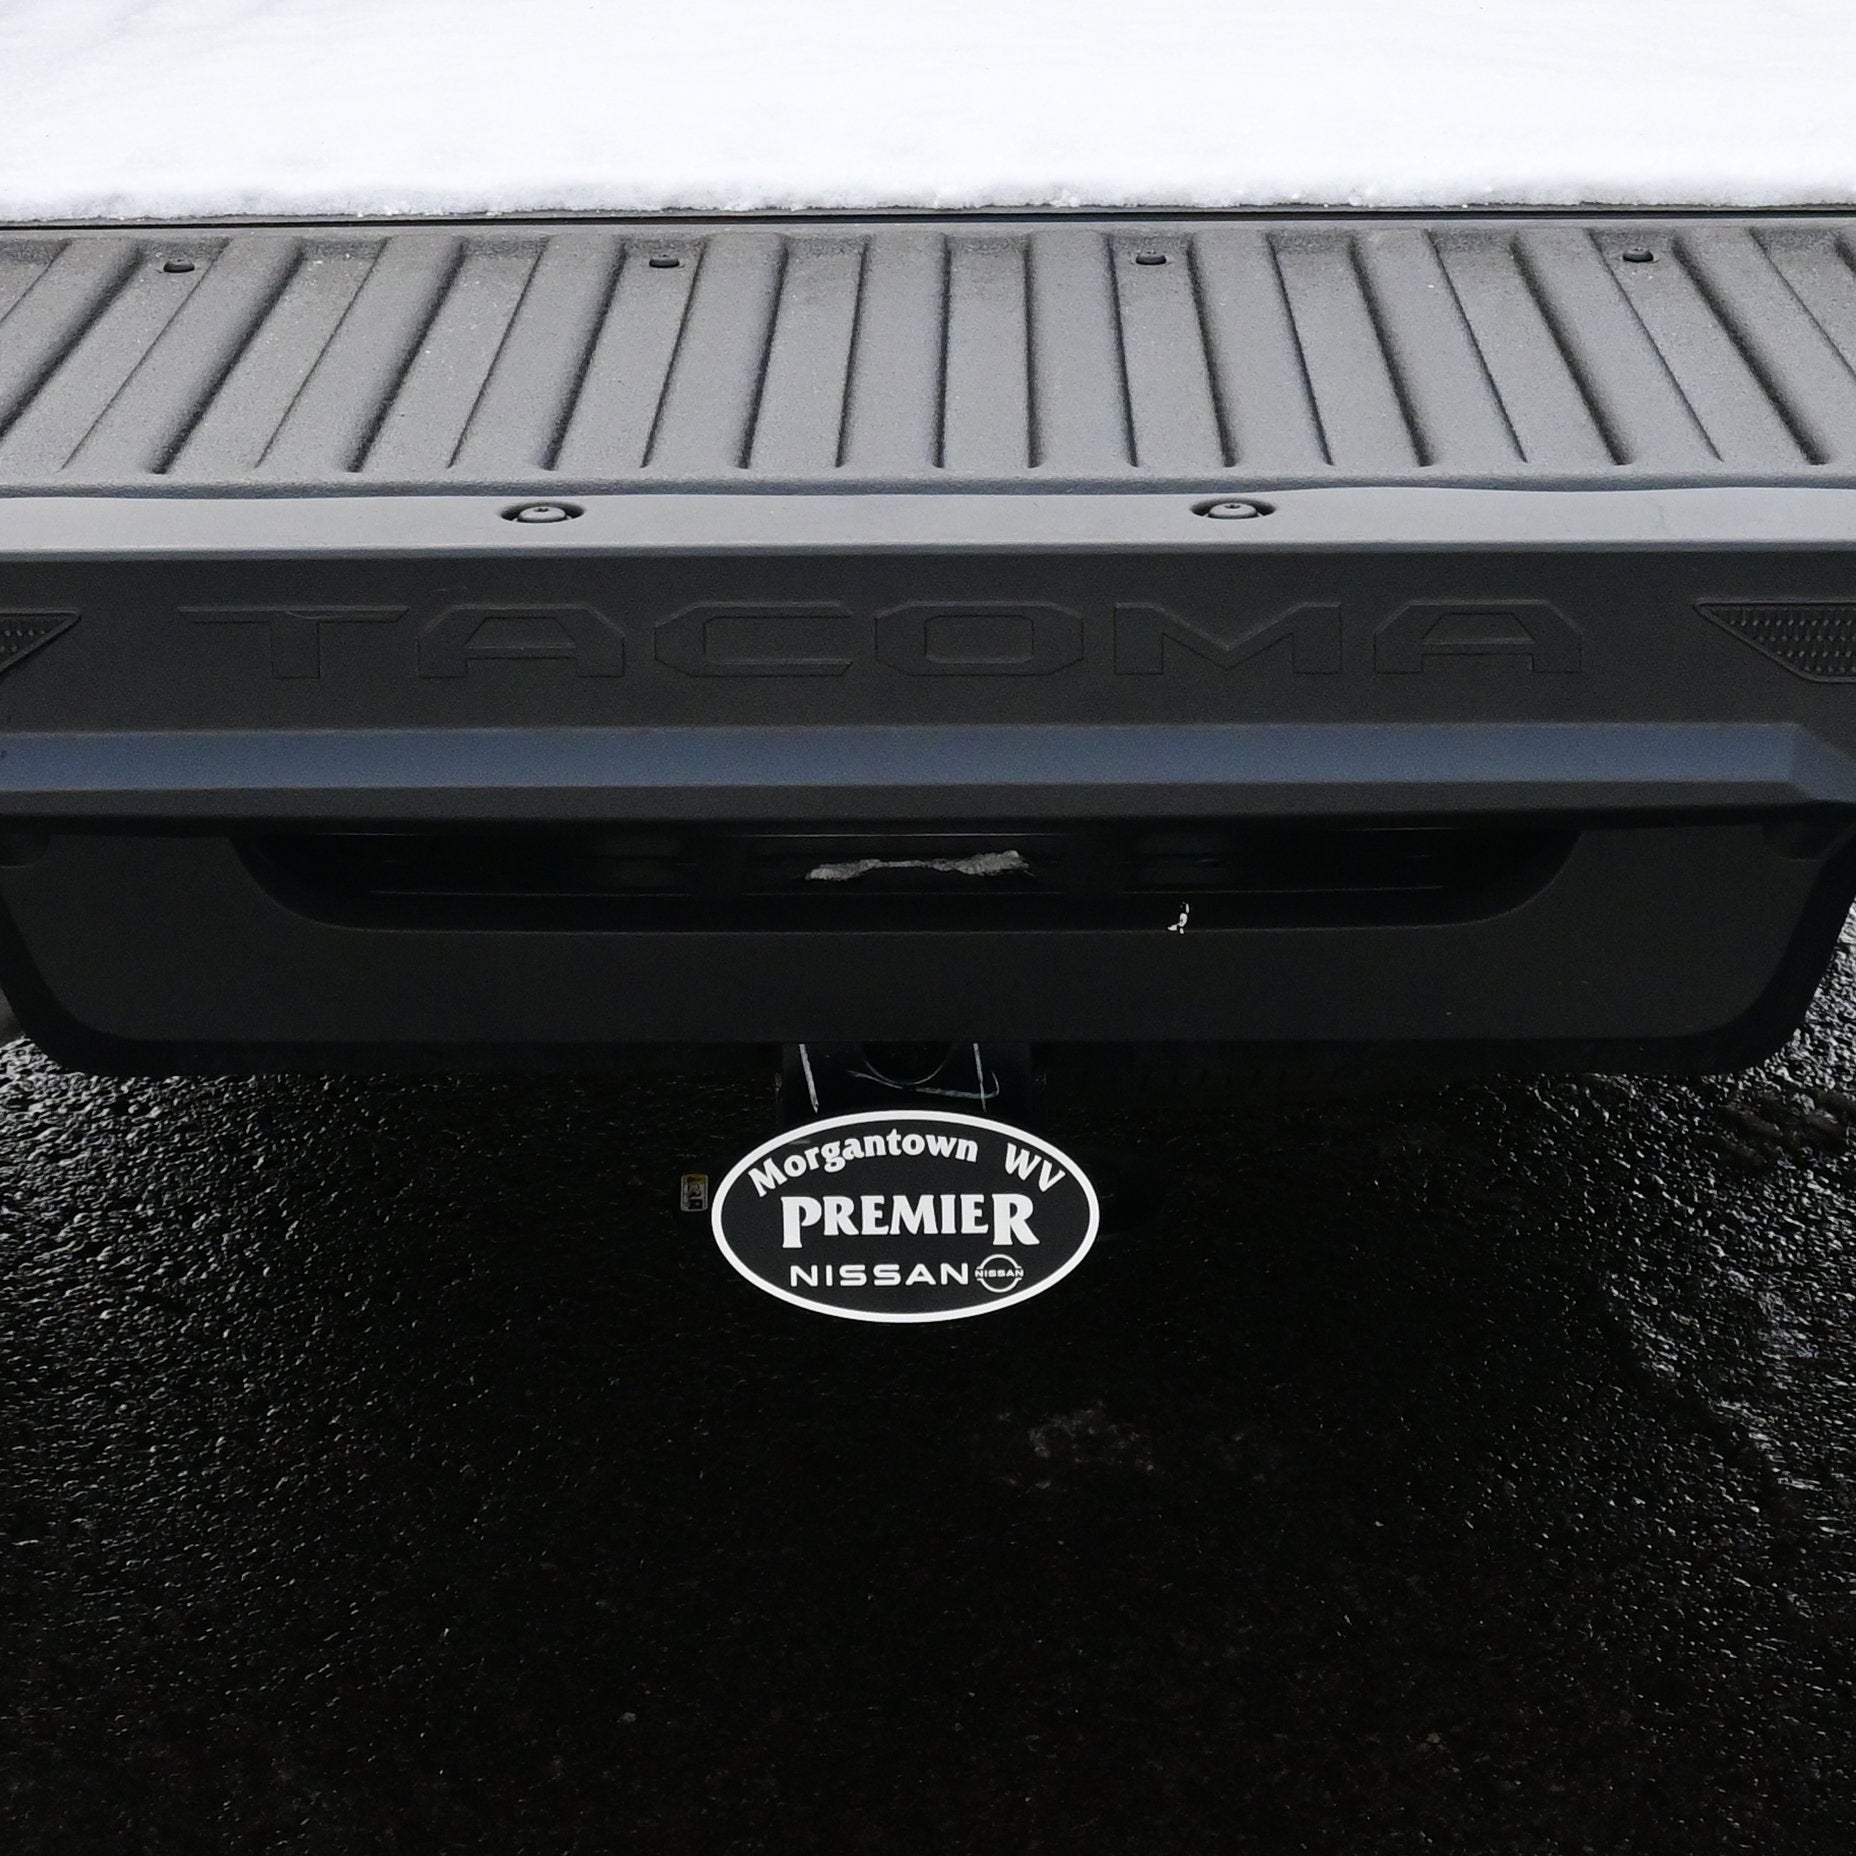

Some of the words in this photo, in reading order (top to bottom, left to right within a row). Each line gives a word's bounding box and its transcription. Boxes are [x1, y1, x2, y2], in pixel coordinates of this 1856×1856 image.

[176, 599, 1584, 680] TACOMA
[747, 1128, 979, 1198] Morgantown
[1004, 1142, 1066, 1193] WV
[780, 1193, 1040, 1249] PREMIER
[789, 1262, 970, 1287] NISSAN
[974, 1268, 1024, 1278] NISSAN
